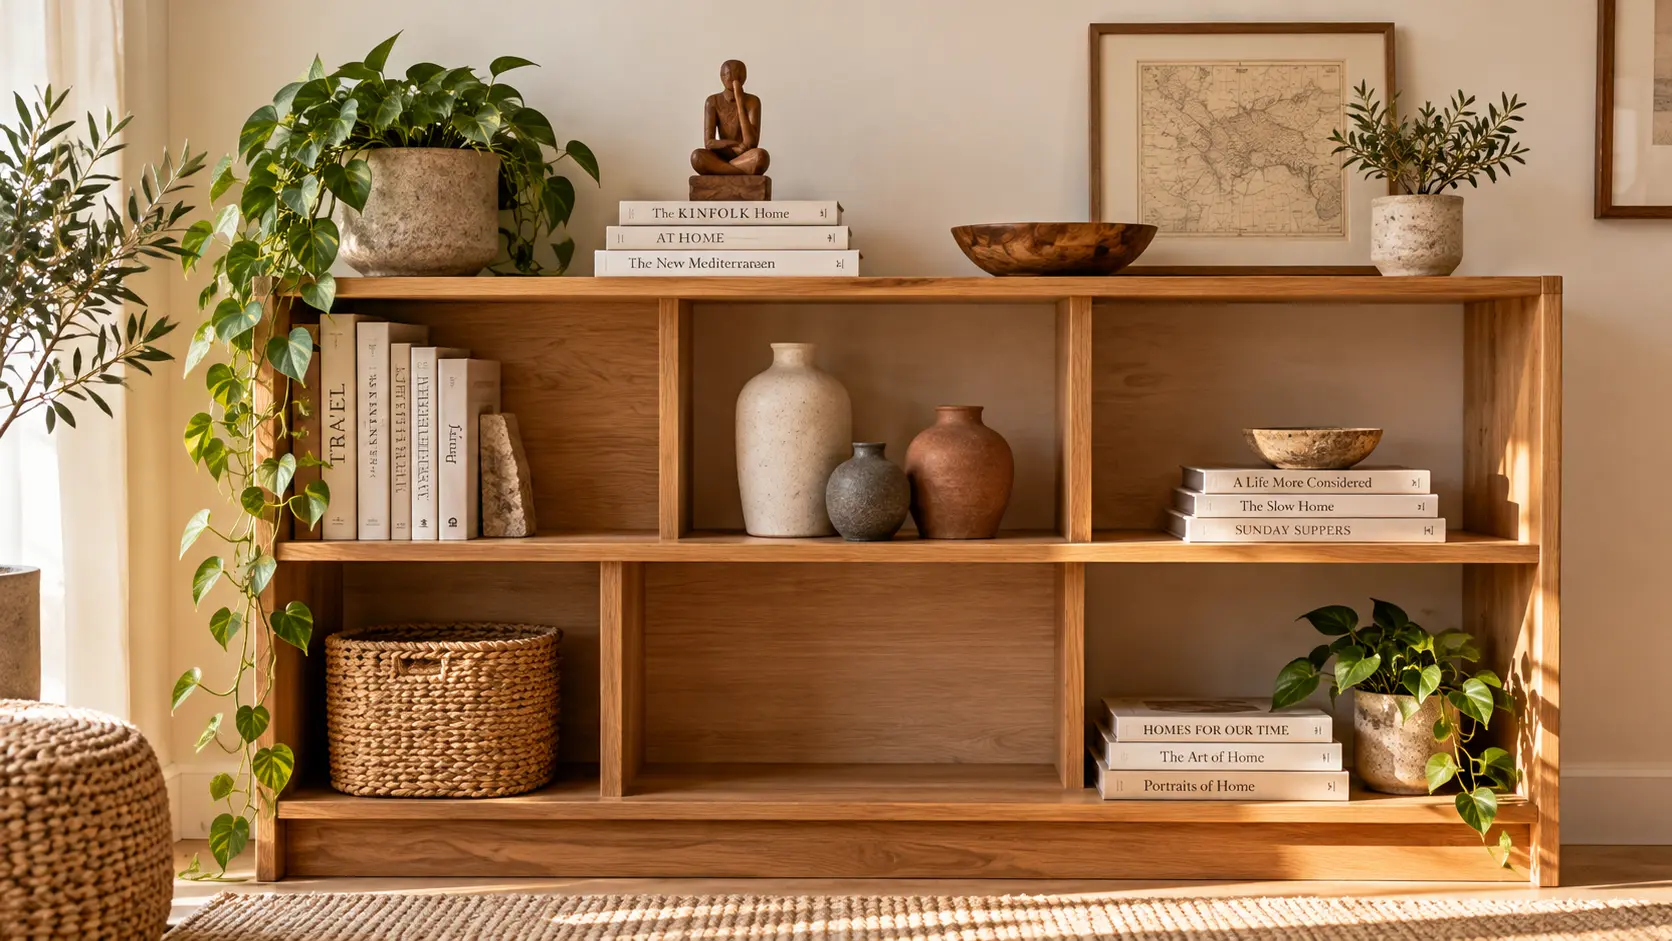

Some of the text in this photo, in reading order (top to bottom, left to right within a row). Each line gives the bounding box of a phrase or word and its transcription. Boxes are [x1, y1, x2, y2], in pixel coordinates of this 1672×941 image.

[651, 207, 790, 219] The KINFOLK Home
[655, 232, 725, 244] AT HOME
[627, 256, 653, 269] The
[656, 256, 686, 270] New
[1233, 475, 1373, 489] A Life More Considered
[1239, 499, 1335, 512] The Slow Home
[1235, 524, 1352, 536] SUNDAY SUPPERS
[1143, 724, 1290, 736] HOMES FOR OUR TIME
[1159, 750, 1265, 764] The Art of Home
[1143, 779, 1256, 793] Portraits of Home
